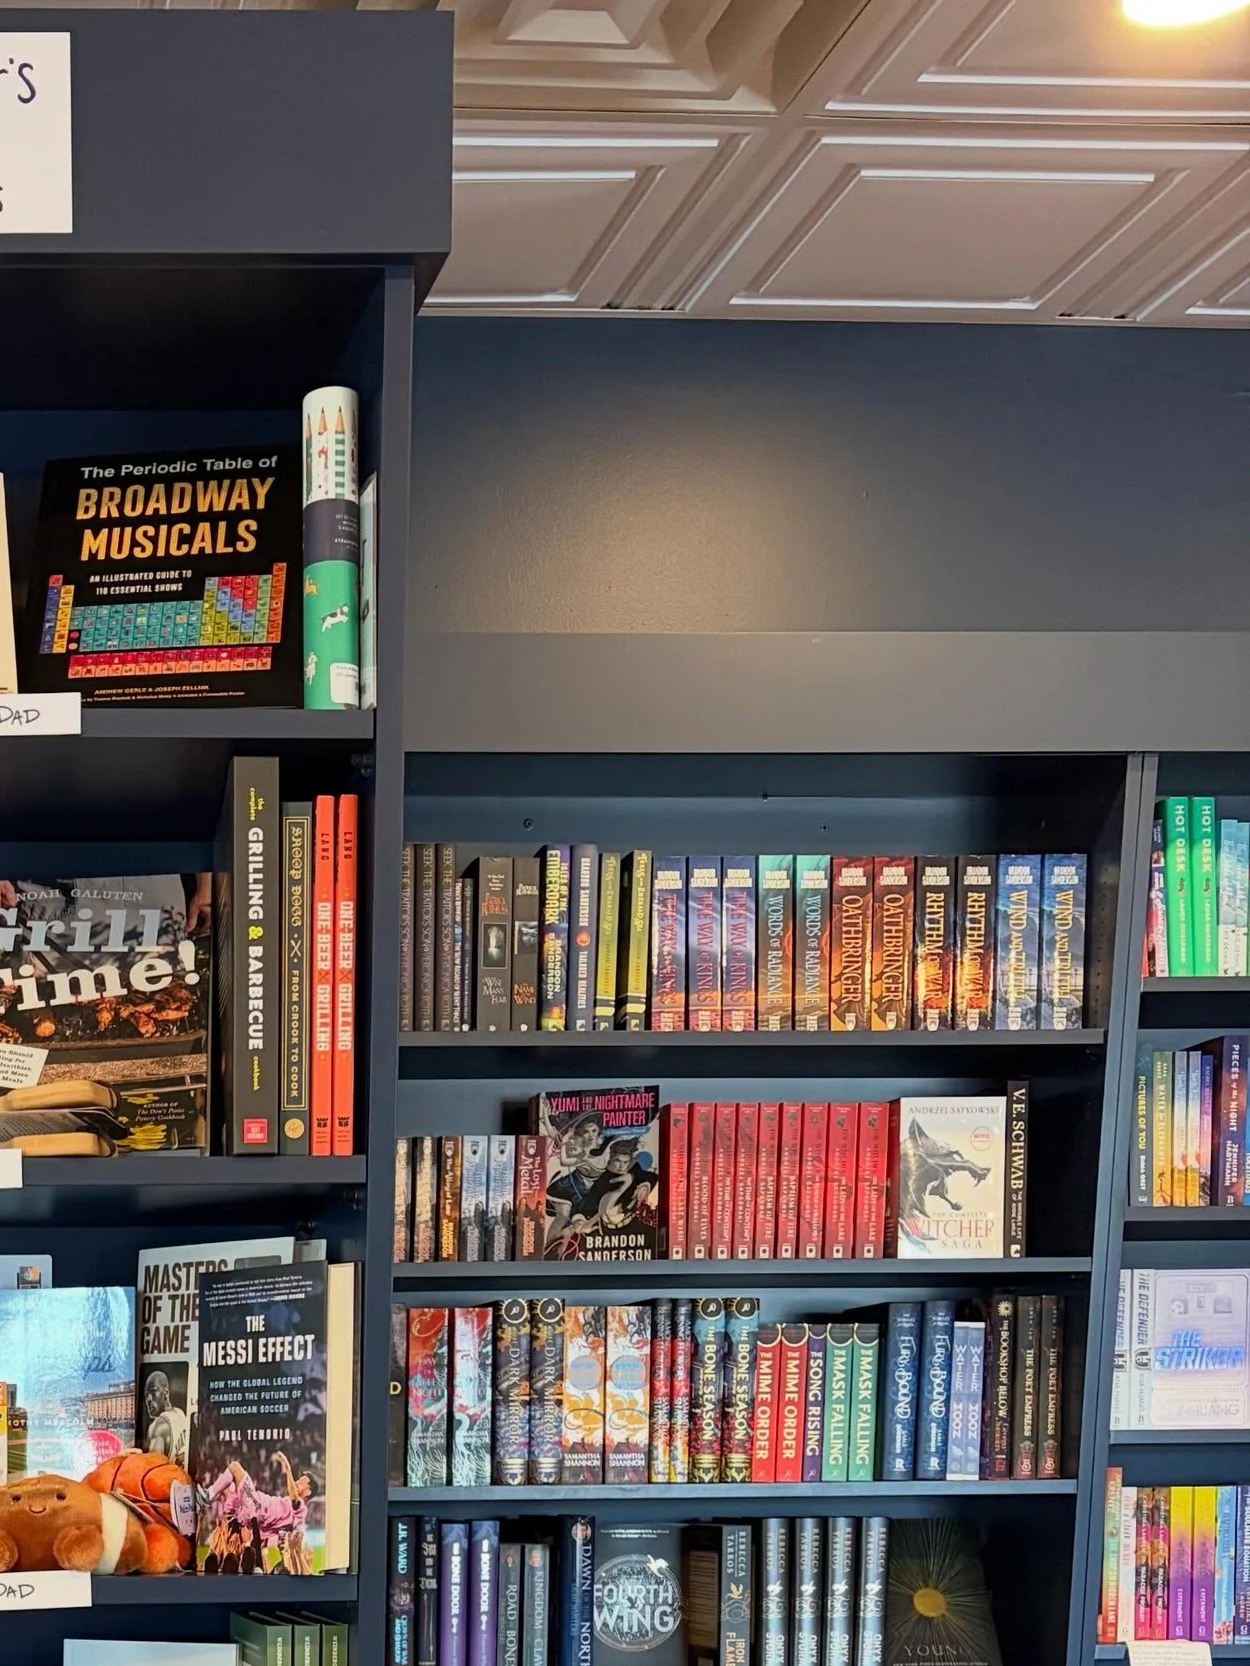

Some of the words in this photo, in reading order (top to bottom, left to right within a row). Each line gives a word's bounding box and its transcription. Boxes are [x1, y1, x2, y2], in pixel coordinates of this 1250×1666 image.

[81, 466, 115, 479] The
[119, 460, 198, 476] Periodic
[203, 457, 253, 470] Table
[258, 455, 278, 469] of
[76, 477, 276, 520] BROADWAY
[80, 519, 258, 561] MUSICALS
[248, 826, 264, 921] GRILLING
[248, 926, 264, 941] &
[842, 894, 863, 1002] OATHBRINGER
[248, 946, 264, 1050] BARBECUE
[550, 1098, 581, 1113] YUMI
[594, 1092, 655, 1111] NIGHTMARE
[602, 1111, 646, 1126] PAINTER
[906, 1218, 994, 1240] WITCHER
[941, 1239, 983, 1249] SAGA
[245, 1315, 265, 1333] THE
[202, 1337, 253, 1367] MESSI
[257, 1333, 315, 1363] EFFECT
[594, 1583, 673, 1605] FOURTH
[593, 1605, 675, 1633] WING
